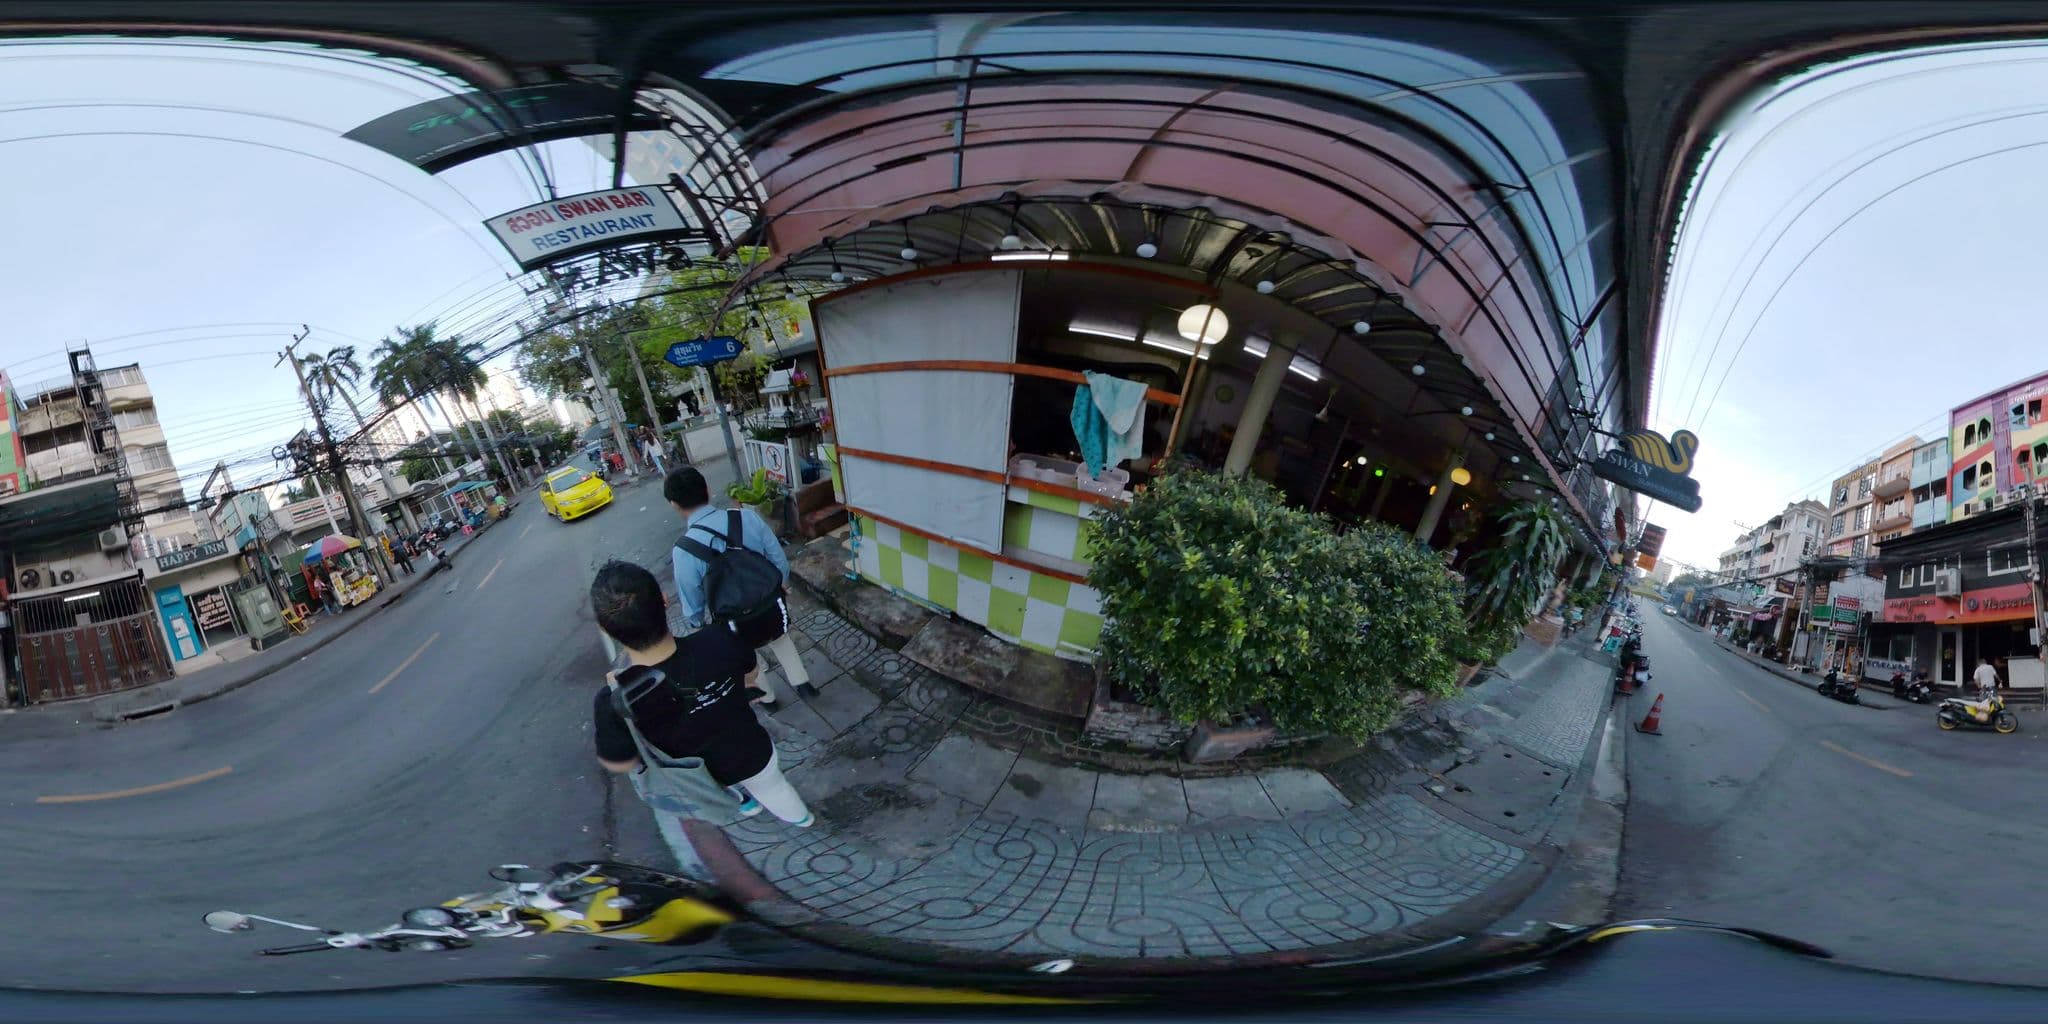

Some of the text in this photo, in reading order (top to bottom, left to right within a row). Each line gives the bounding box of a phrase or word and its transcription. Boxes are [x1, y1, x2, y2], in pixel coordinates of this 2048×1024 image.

[506, 209, 556, 233] สวอน
[531, 213, 657, 250] RESTAURANT
[726, 341, 736, 353] 6
[1607, 452, 1653, 477] SWAN
[160, 540, 226, 568] HAPPY INN
